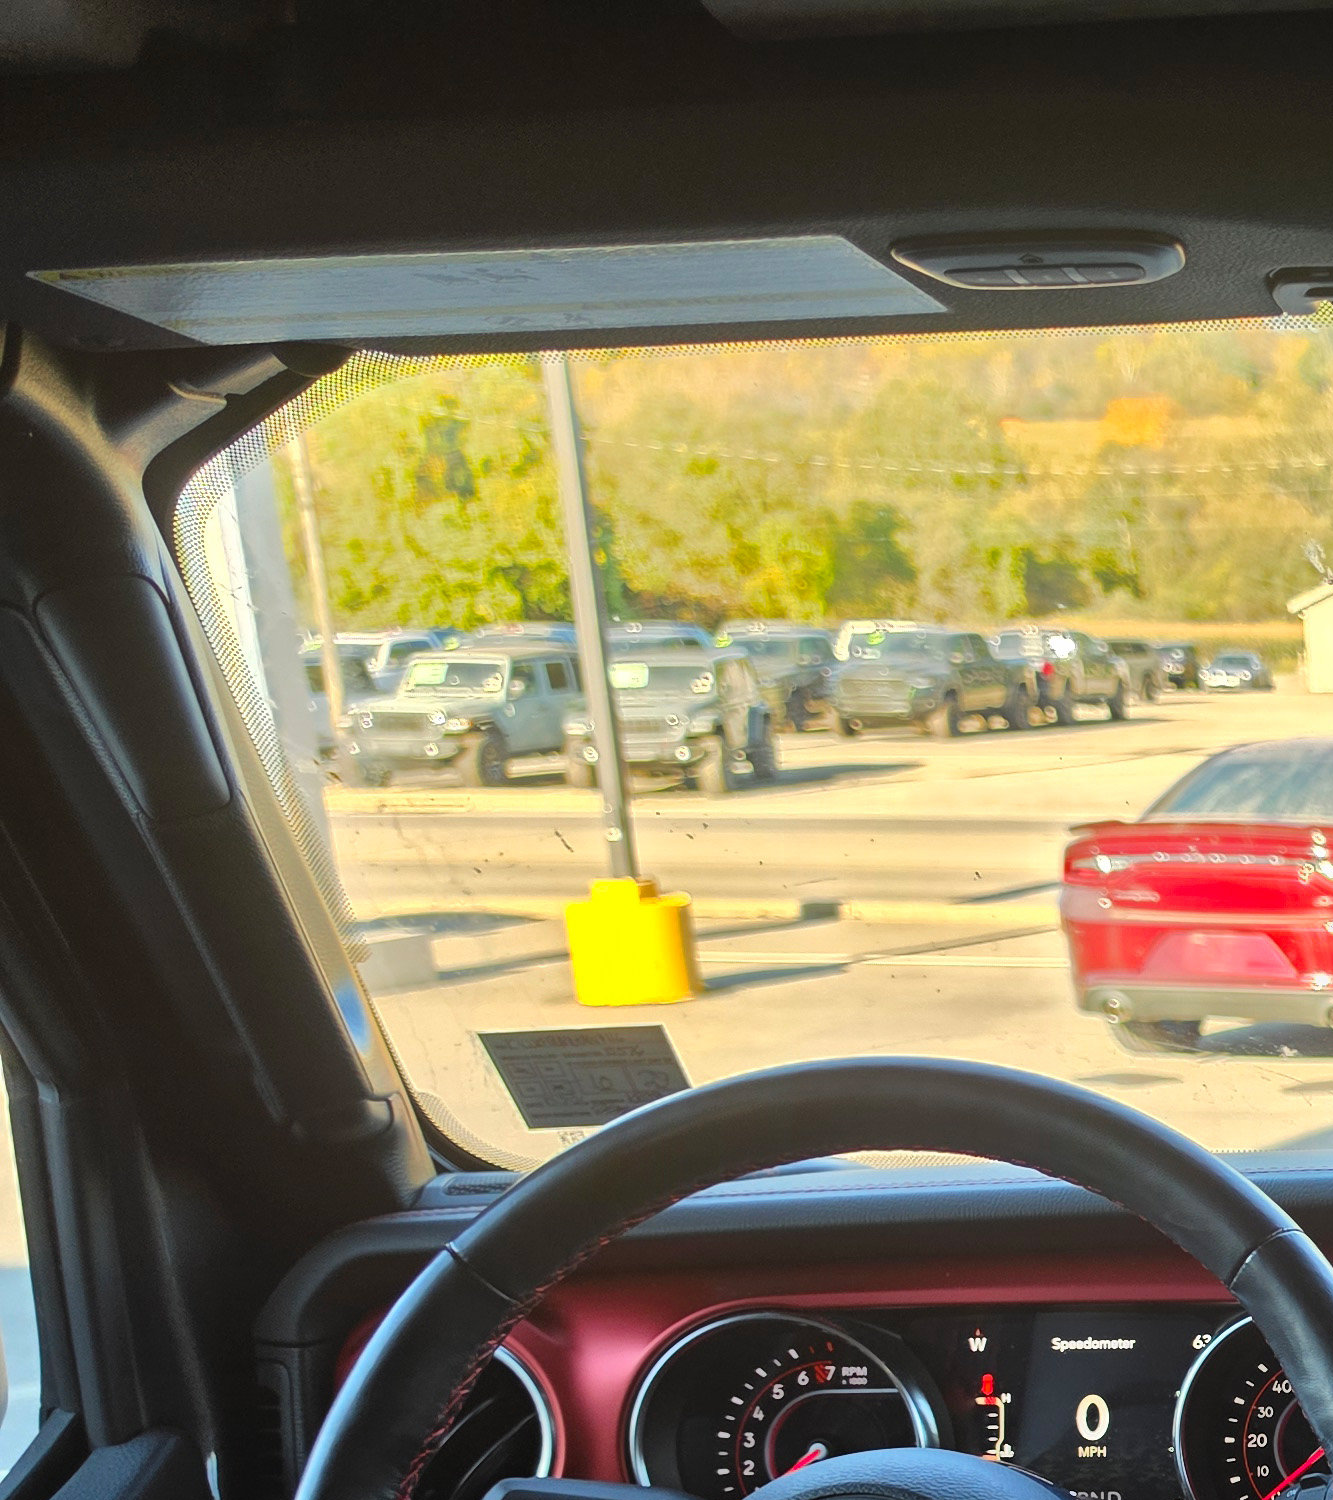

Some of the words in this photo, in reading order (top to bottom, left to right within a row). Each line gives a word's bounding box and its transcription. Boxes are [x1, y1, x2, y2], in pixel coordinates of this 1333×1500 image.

[968, 1337, 987, 1352] W
[1051, 1337, 1137, 1352] Speedometer
[797, 1371, 809, 1386] 6
[825, 1365, 836, 1381] 7
[841, 1366, 868, 1377] RPM
[772, 1384, 785, 1400] 5
[1272, 1380, 1293, 1394] 40
[752, 1406, 765, 1421] 4
[1076, 1394, 1110, 1441] 0
[1257, 1406, 1274, 1419] 30
[743, 1432, 755, 1448] 3
[1247, 1434, 1268, 1448] 20
[1077, 1446, 1108, 1458] MPH
[743, 1460, 755, 1476] 2
[1257, 1465, 1270, 1478] 10
